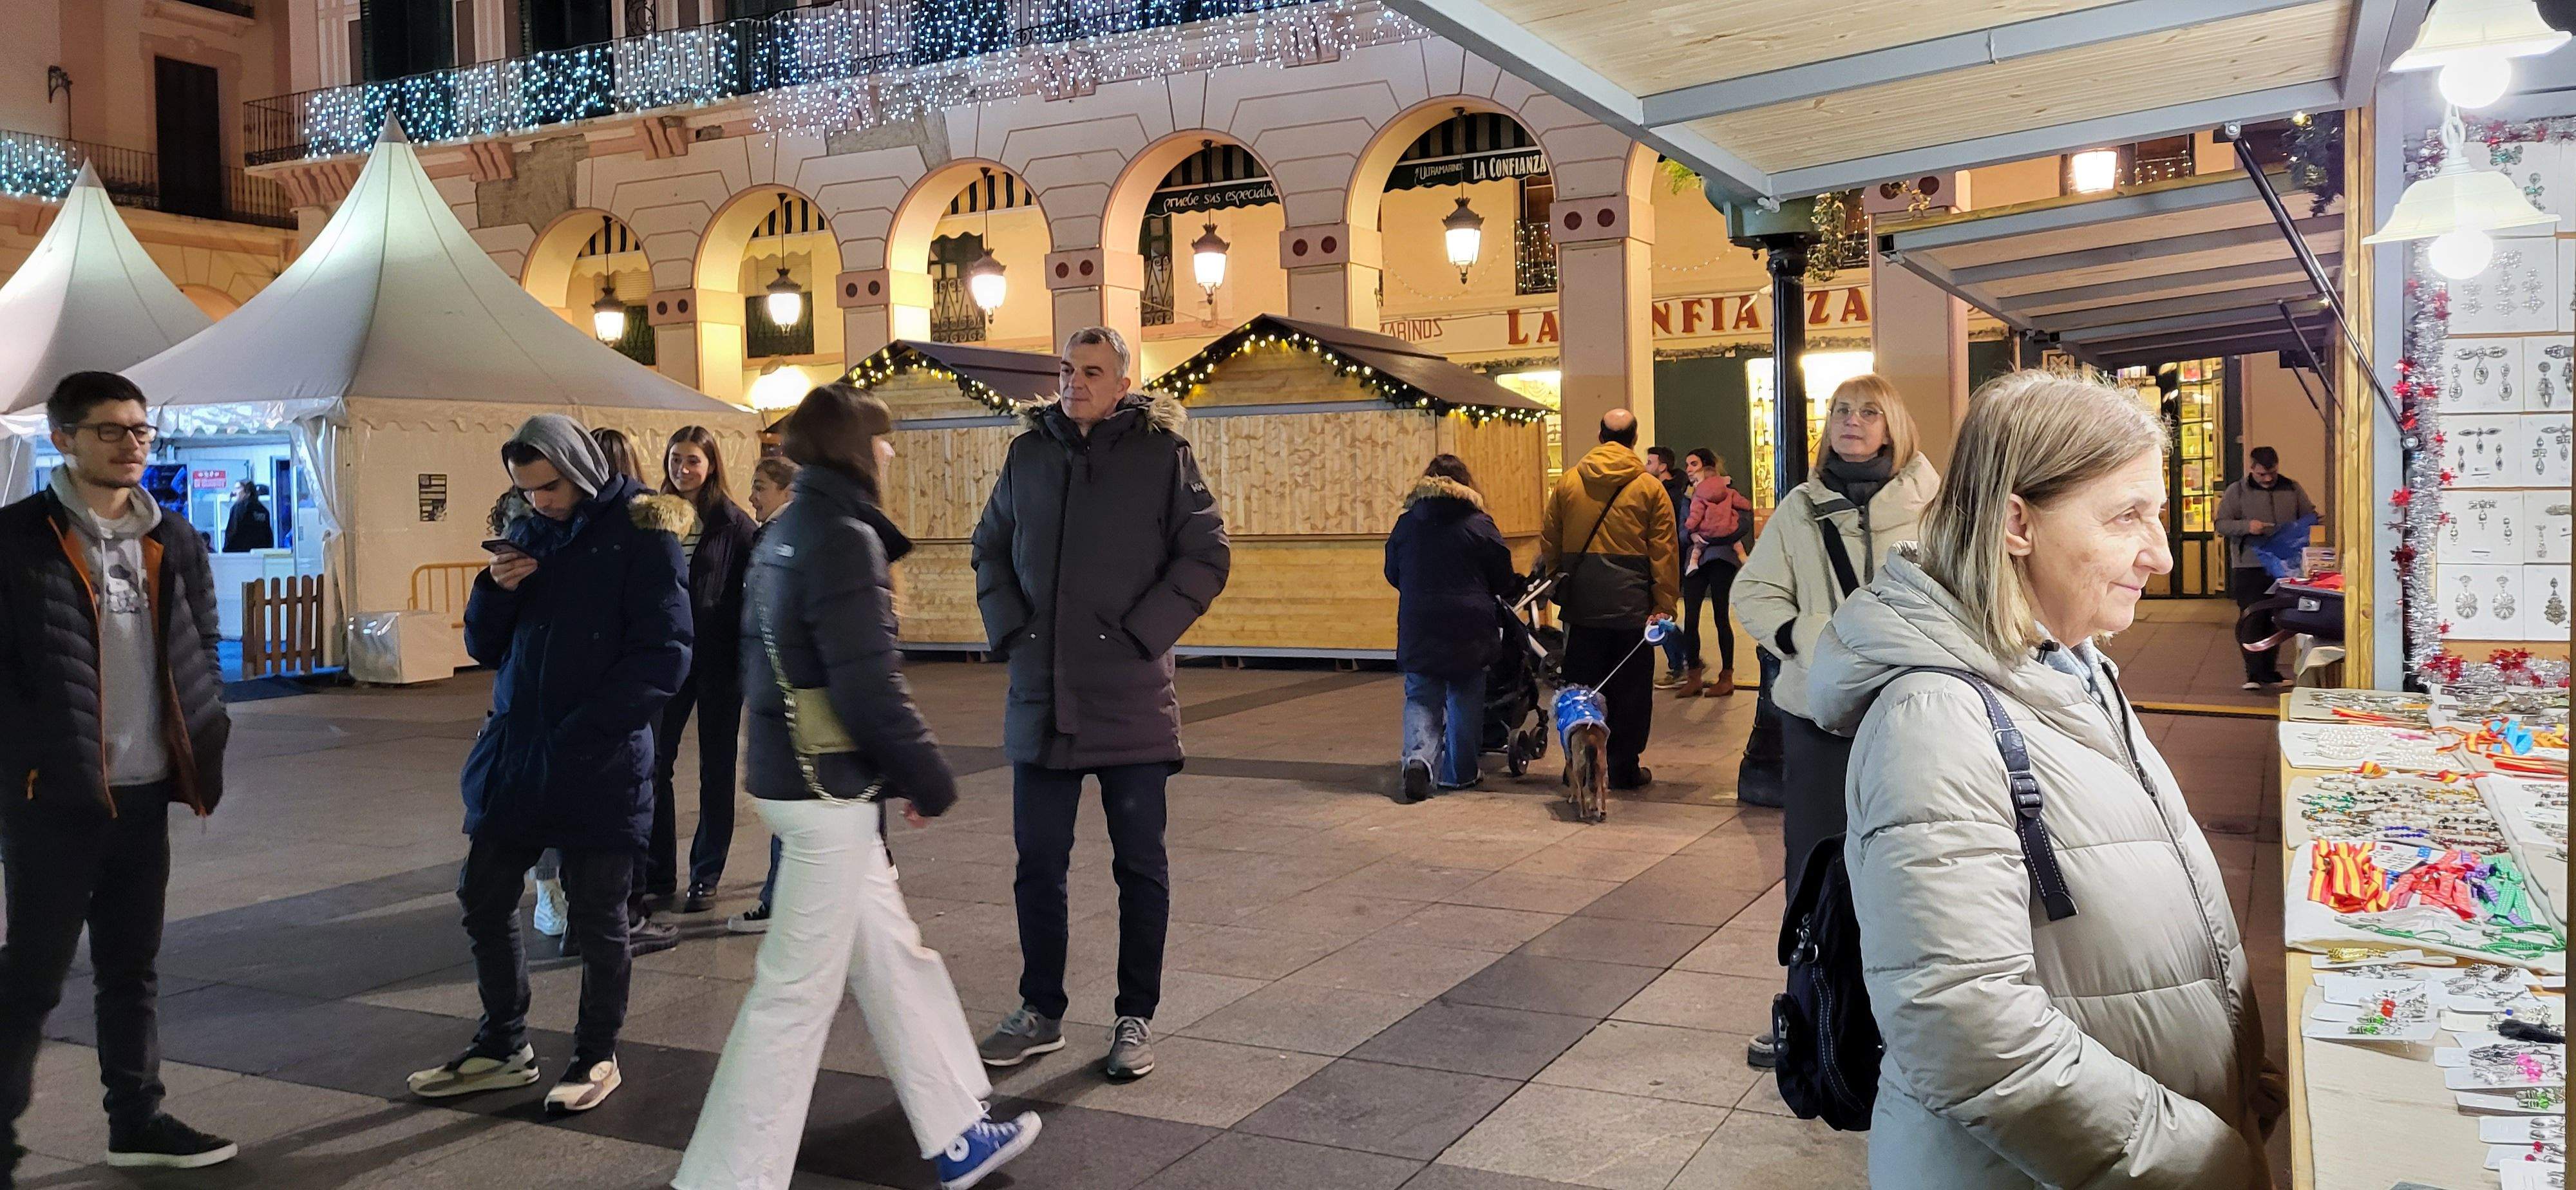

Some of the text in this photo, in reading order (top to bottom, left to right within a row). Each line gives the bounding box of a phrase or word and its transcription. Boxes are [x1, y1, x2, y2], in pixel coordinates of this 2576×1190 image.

[1489, 155, 1547, 178] CONFIANZA
[1163, 193, 1200, 212] pruebe
[1225, 183, 1278, 206] especialid
[1507, 309, 1559, 345] LA
